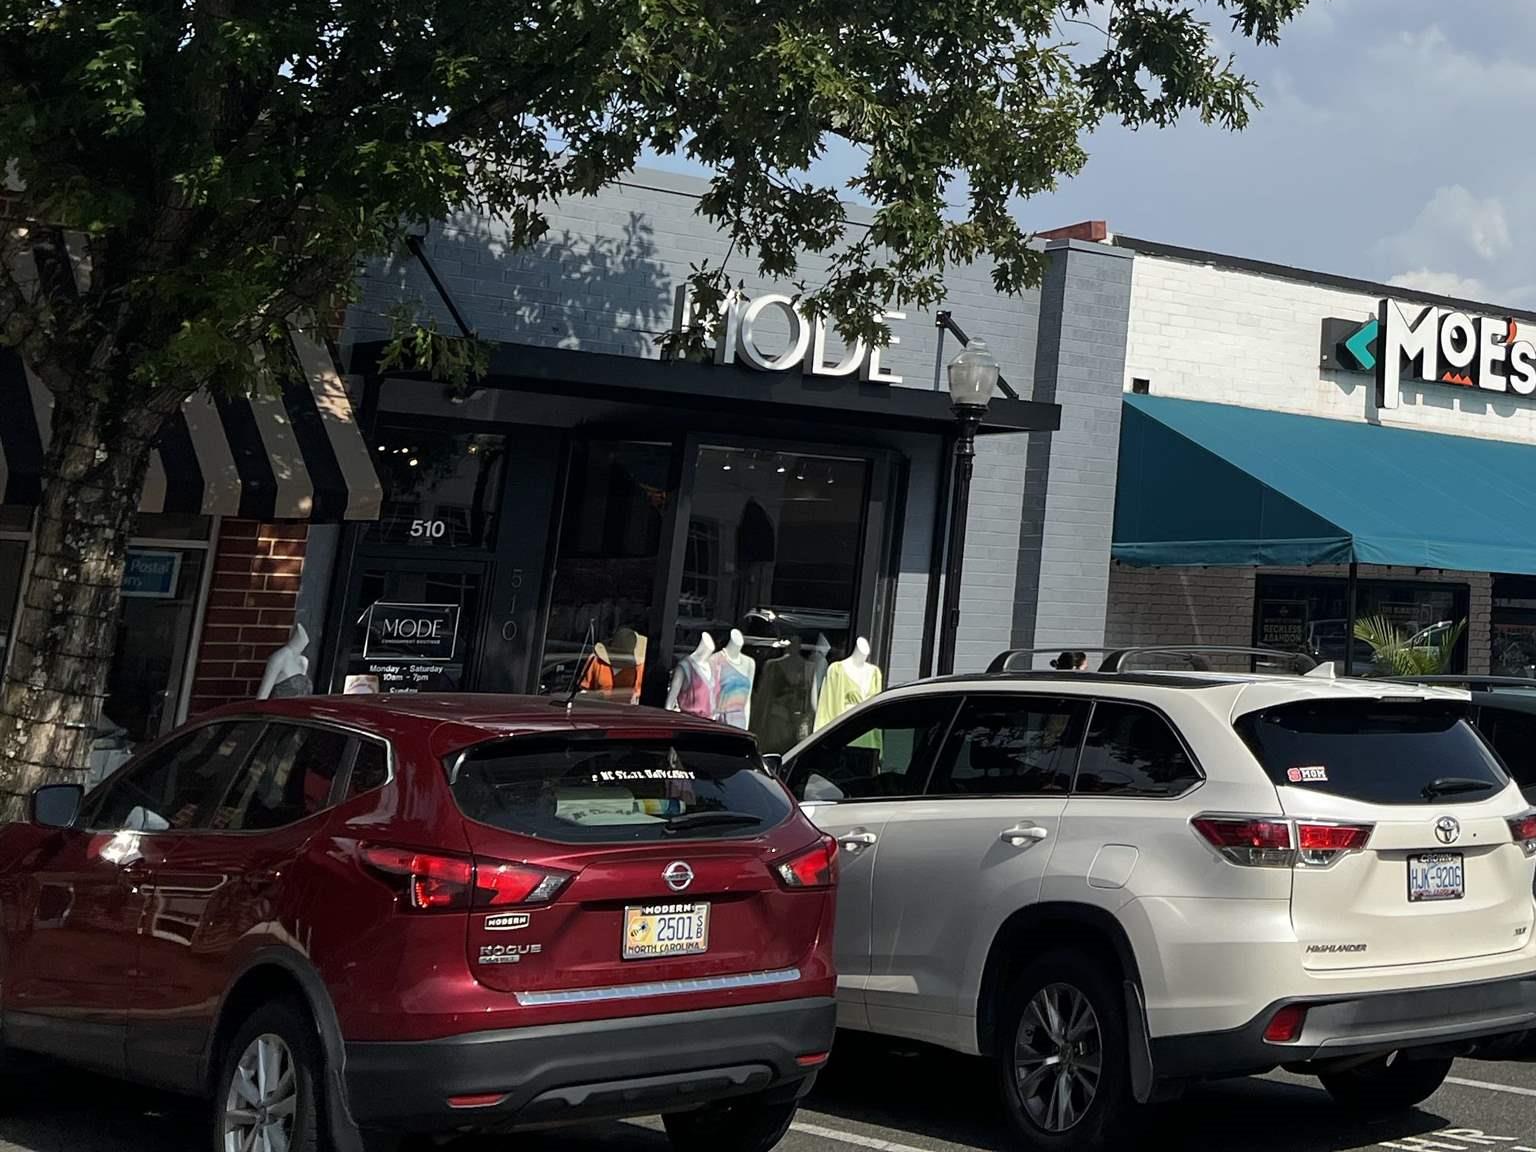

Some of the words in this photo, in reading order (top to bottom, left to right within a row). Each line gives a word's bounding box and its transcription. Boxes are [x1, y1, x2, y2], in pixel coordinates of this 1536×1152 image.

[410, 520, 445, 538] 510
[382, 618, 444, 638] MODE
[369, 665, 401, 674] Monday
[409, 665, 444, 674] Saturday
[412, 674, 429, 682] 7pm
[1411, 866, 1461, 889] HJK-9206
[645, 904, 691, 914] MODERN
[488, 917, 526, 926] MODERN
[657, 916, 693, 942] 2501
[480, 944, 541, 956] ROGUE
[628, 944, 659, 954] NORTH
[660, 942, 700, 953] CAROLINA
[1305, 944, 1367, 953] HIGHLANDER
